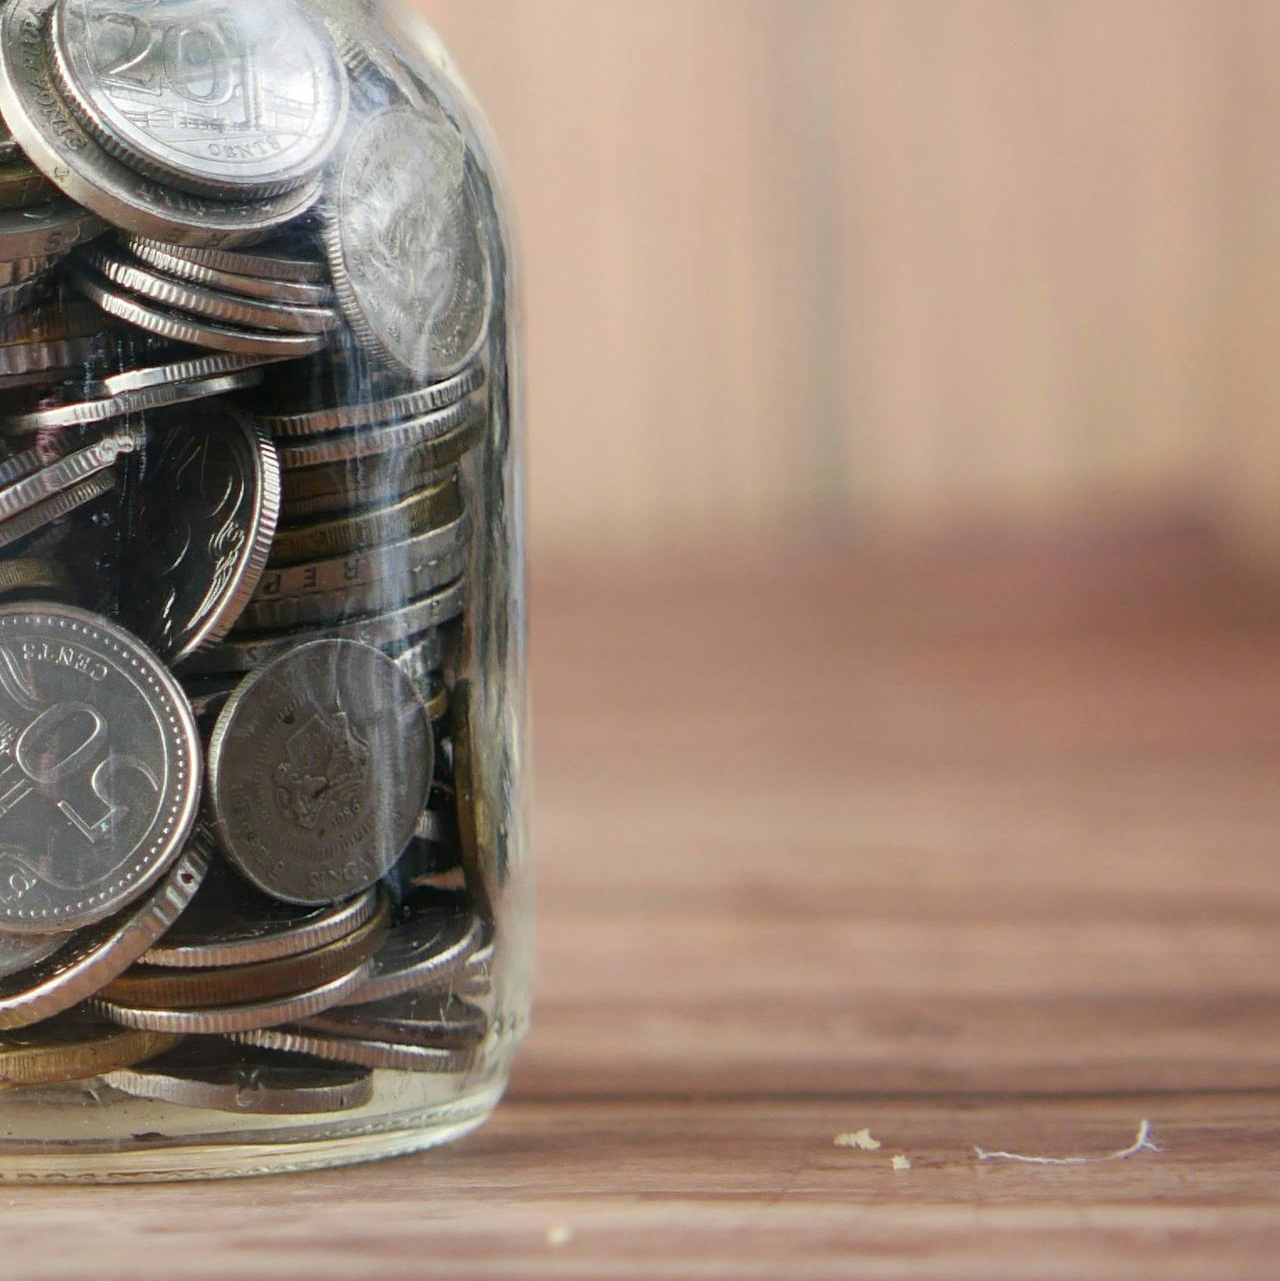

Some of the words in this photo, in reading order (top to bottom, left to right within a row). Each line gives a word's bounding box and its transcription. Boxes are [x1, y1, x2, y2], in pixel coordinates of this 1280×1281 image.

[96, 13, 237, 106] 20
[207, 134, 281, 161] CENTS
[22, 641, 109, 682] CENTS
[16, 700, 161, 843] 50
